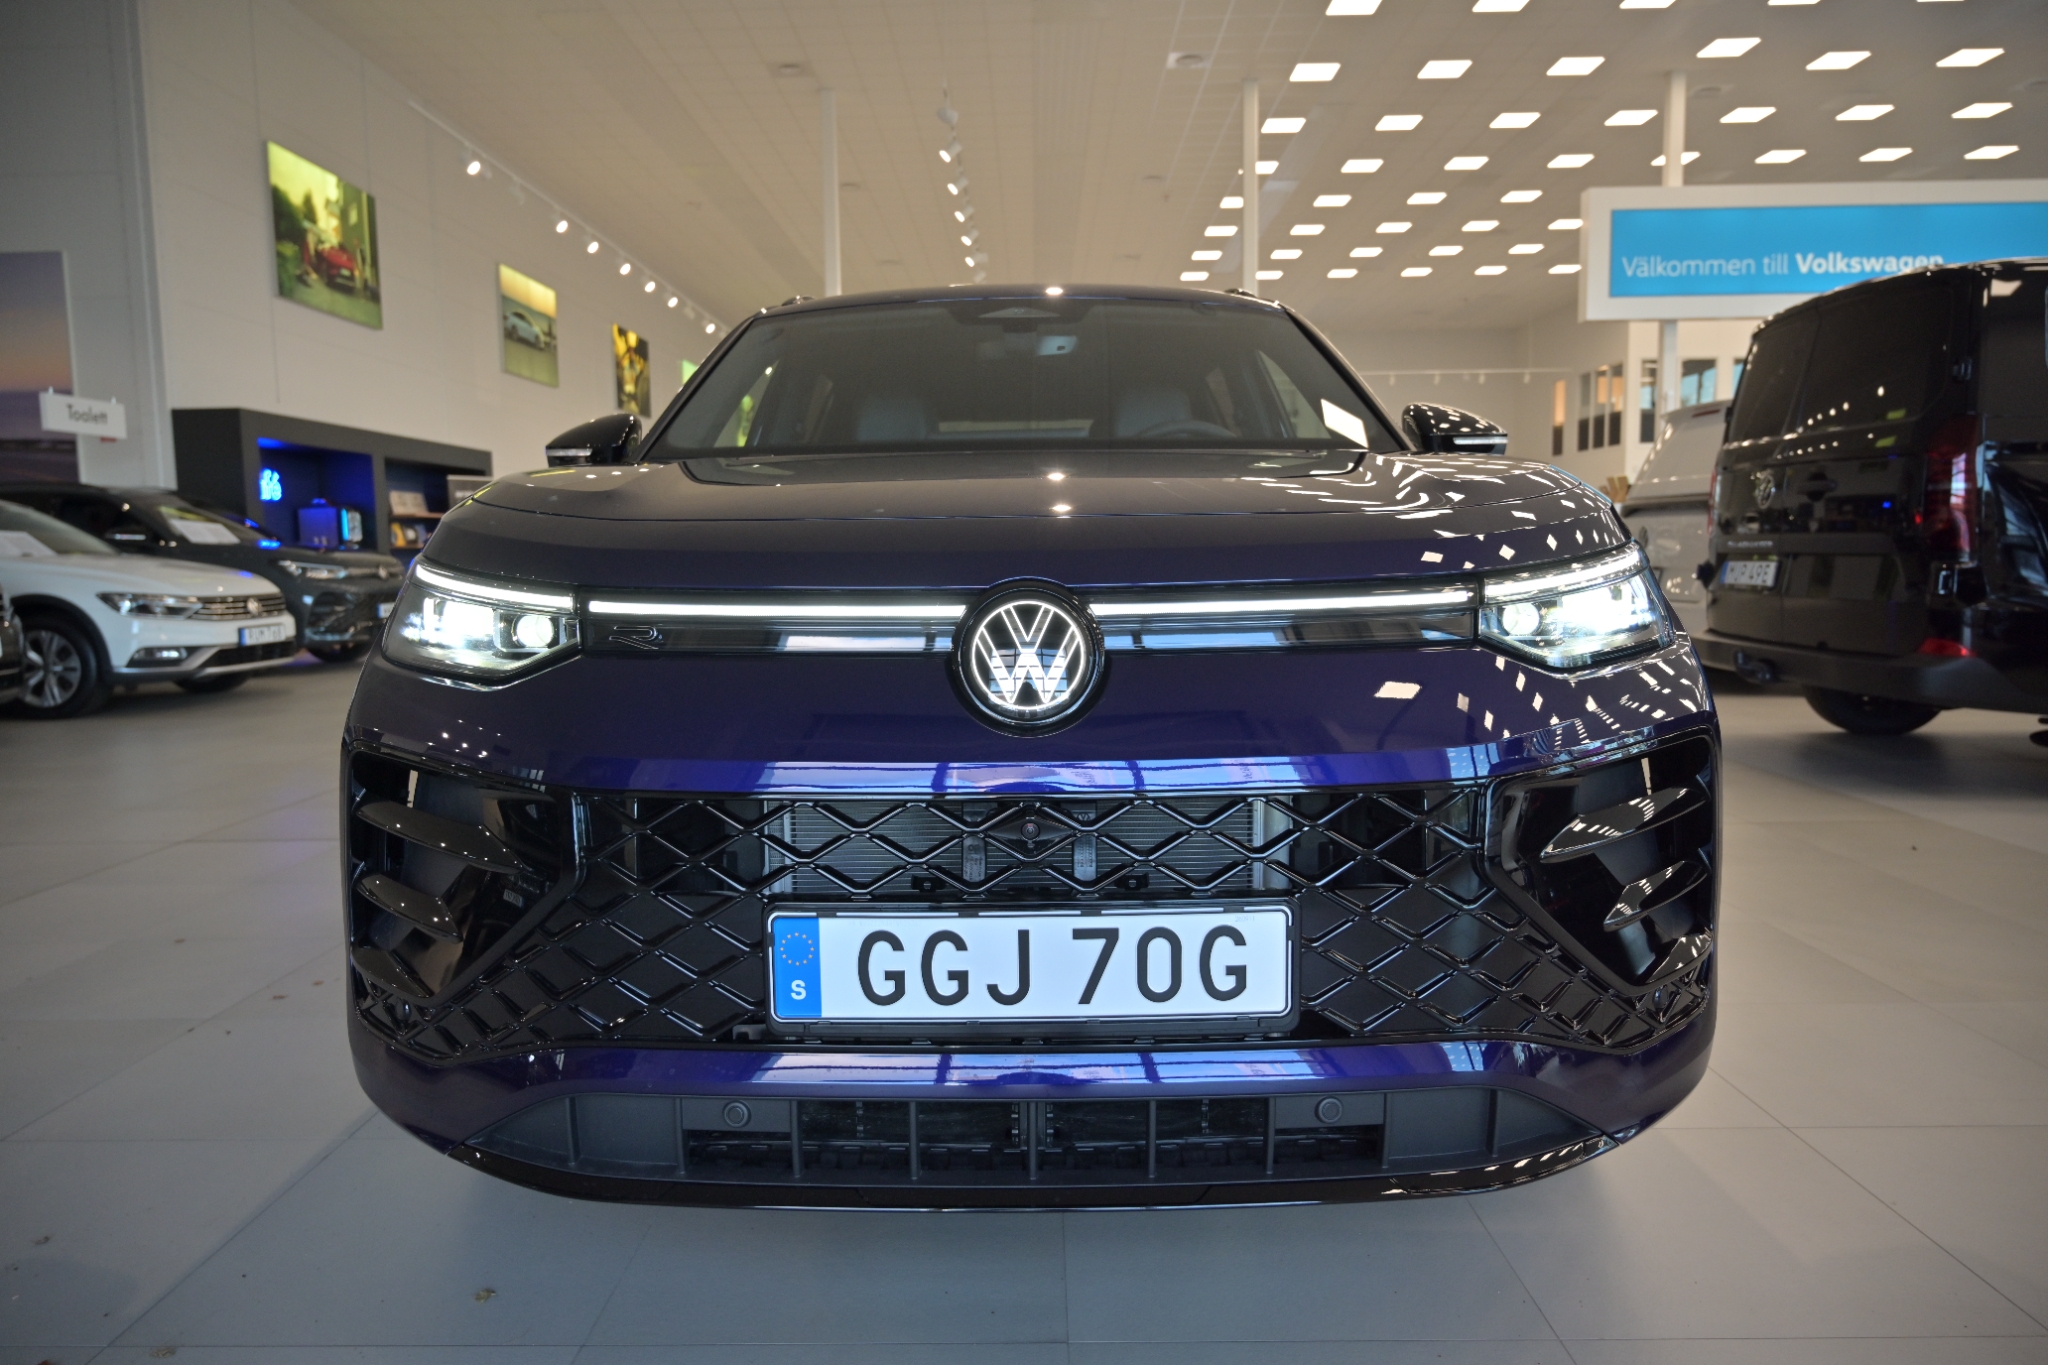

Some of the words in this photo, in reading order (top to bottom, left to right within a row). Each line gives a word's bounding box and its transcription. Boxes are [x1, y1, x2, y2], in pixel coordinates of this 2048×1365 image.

[1622, 256, 1756, 277] Välkommen
[1763, 253, 1789, 275] till
[67, 404, 108, 424] Toalett
[857, 929, 1031, 1006] GGJ
[1072, 925, 1248, 1005] 70G
[790, 979, 807, 1000] S
